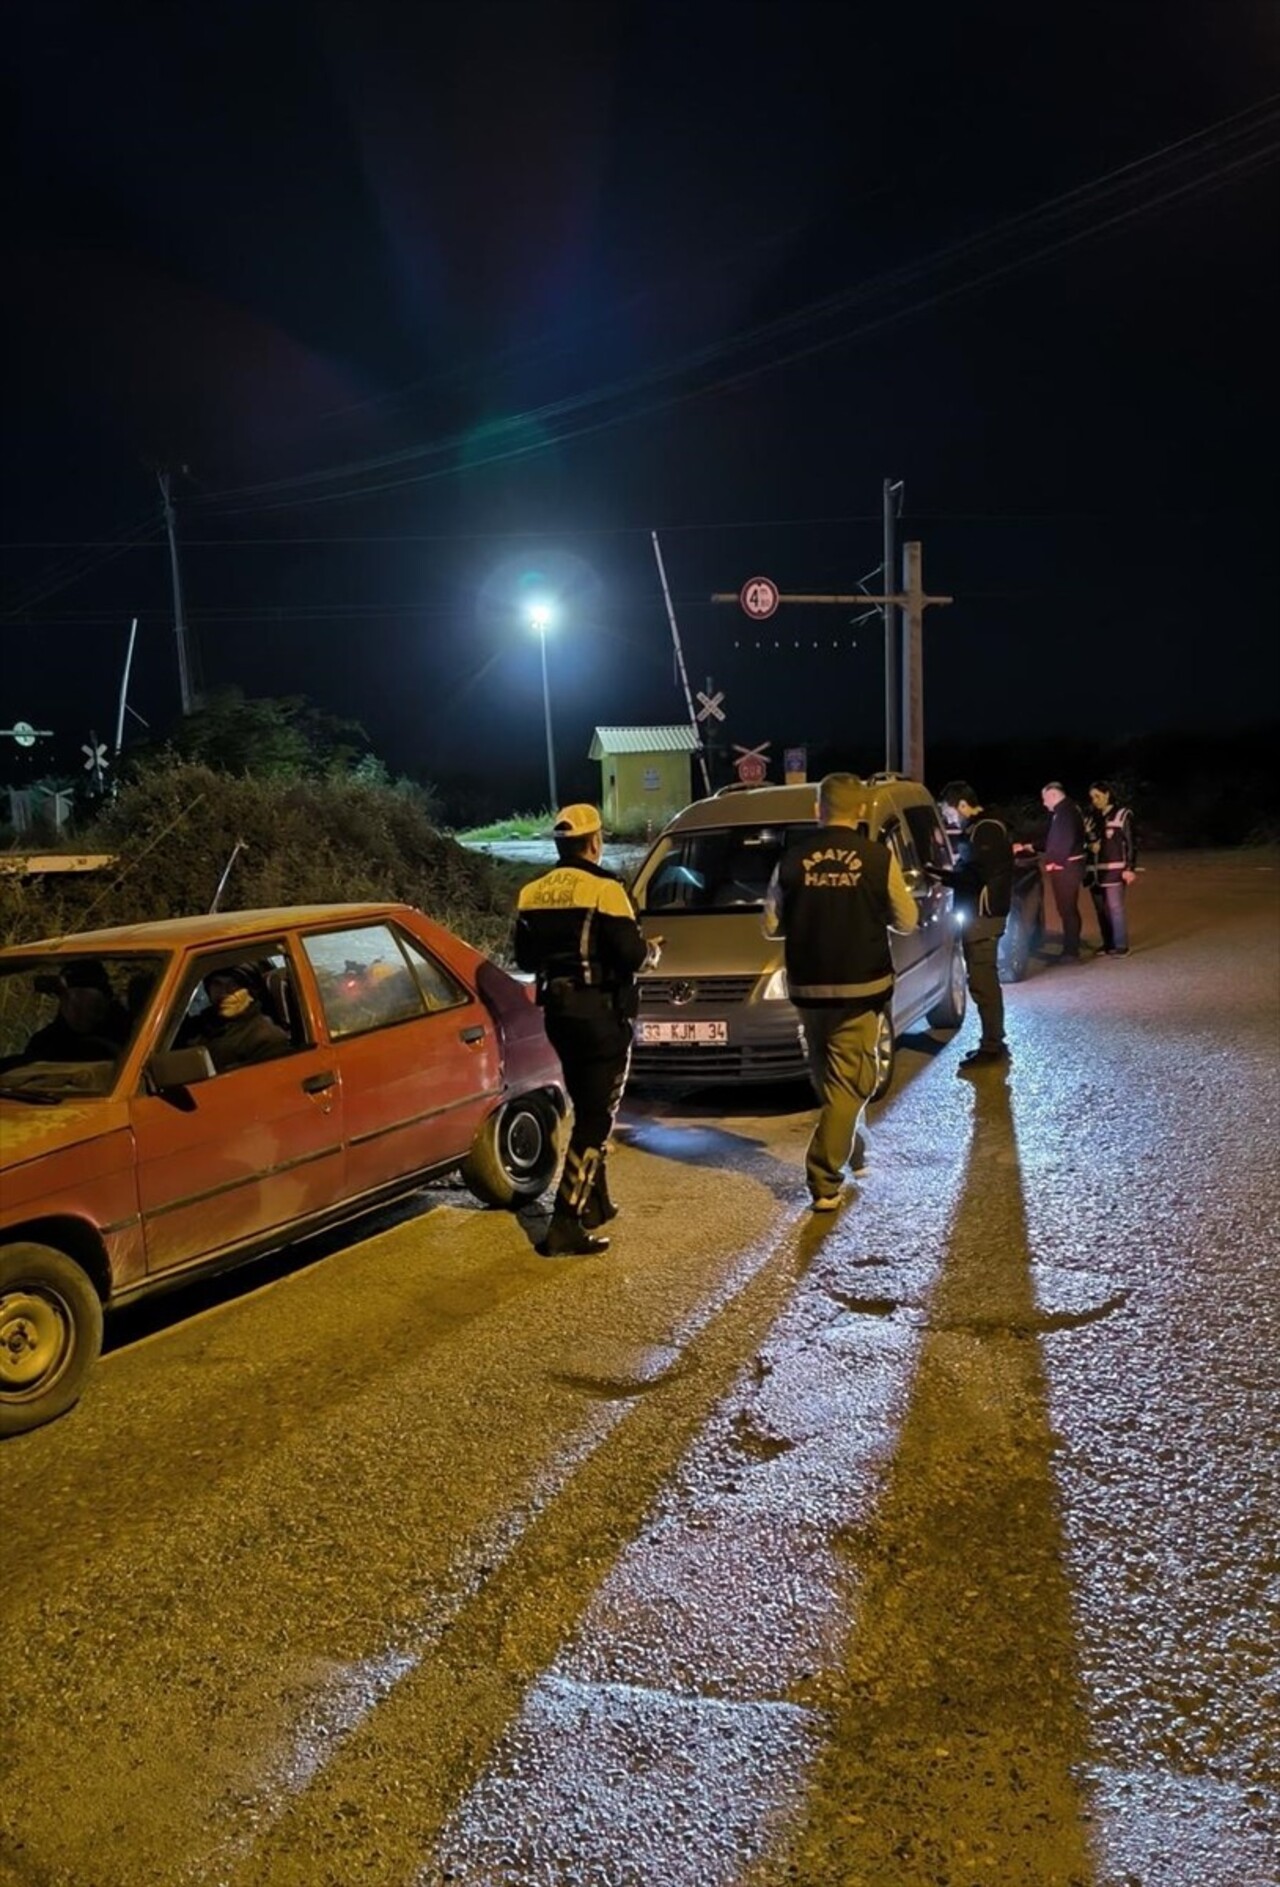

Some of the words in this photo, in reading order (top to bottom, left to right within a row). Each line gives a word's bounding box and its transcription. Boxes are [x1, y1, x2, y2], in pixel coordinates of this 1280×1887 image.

[749, 589, 759, 607] 4
[804, 873, 861, 886] HATAY
[671, 1023, 696, 1040] KJM
[708, 1023, 724, 1039] 34
